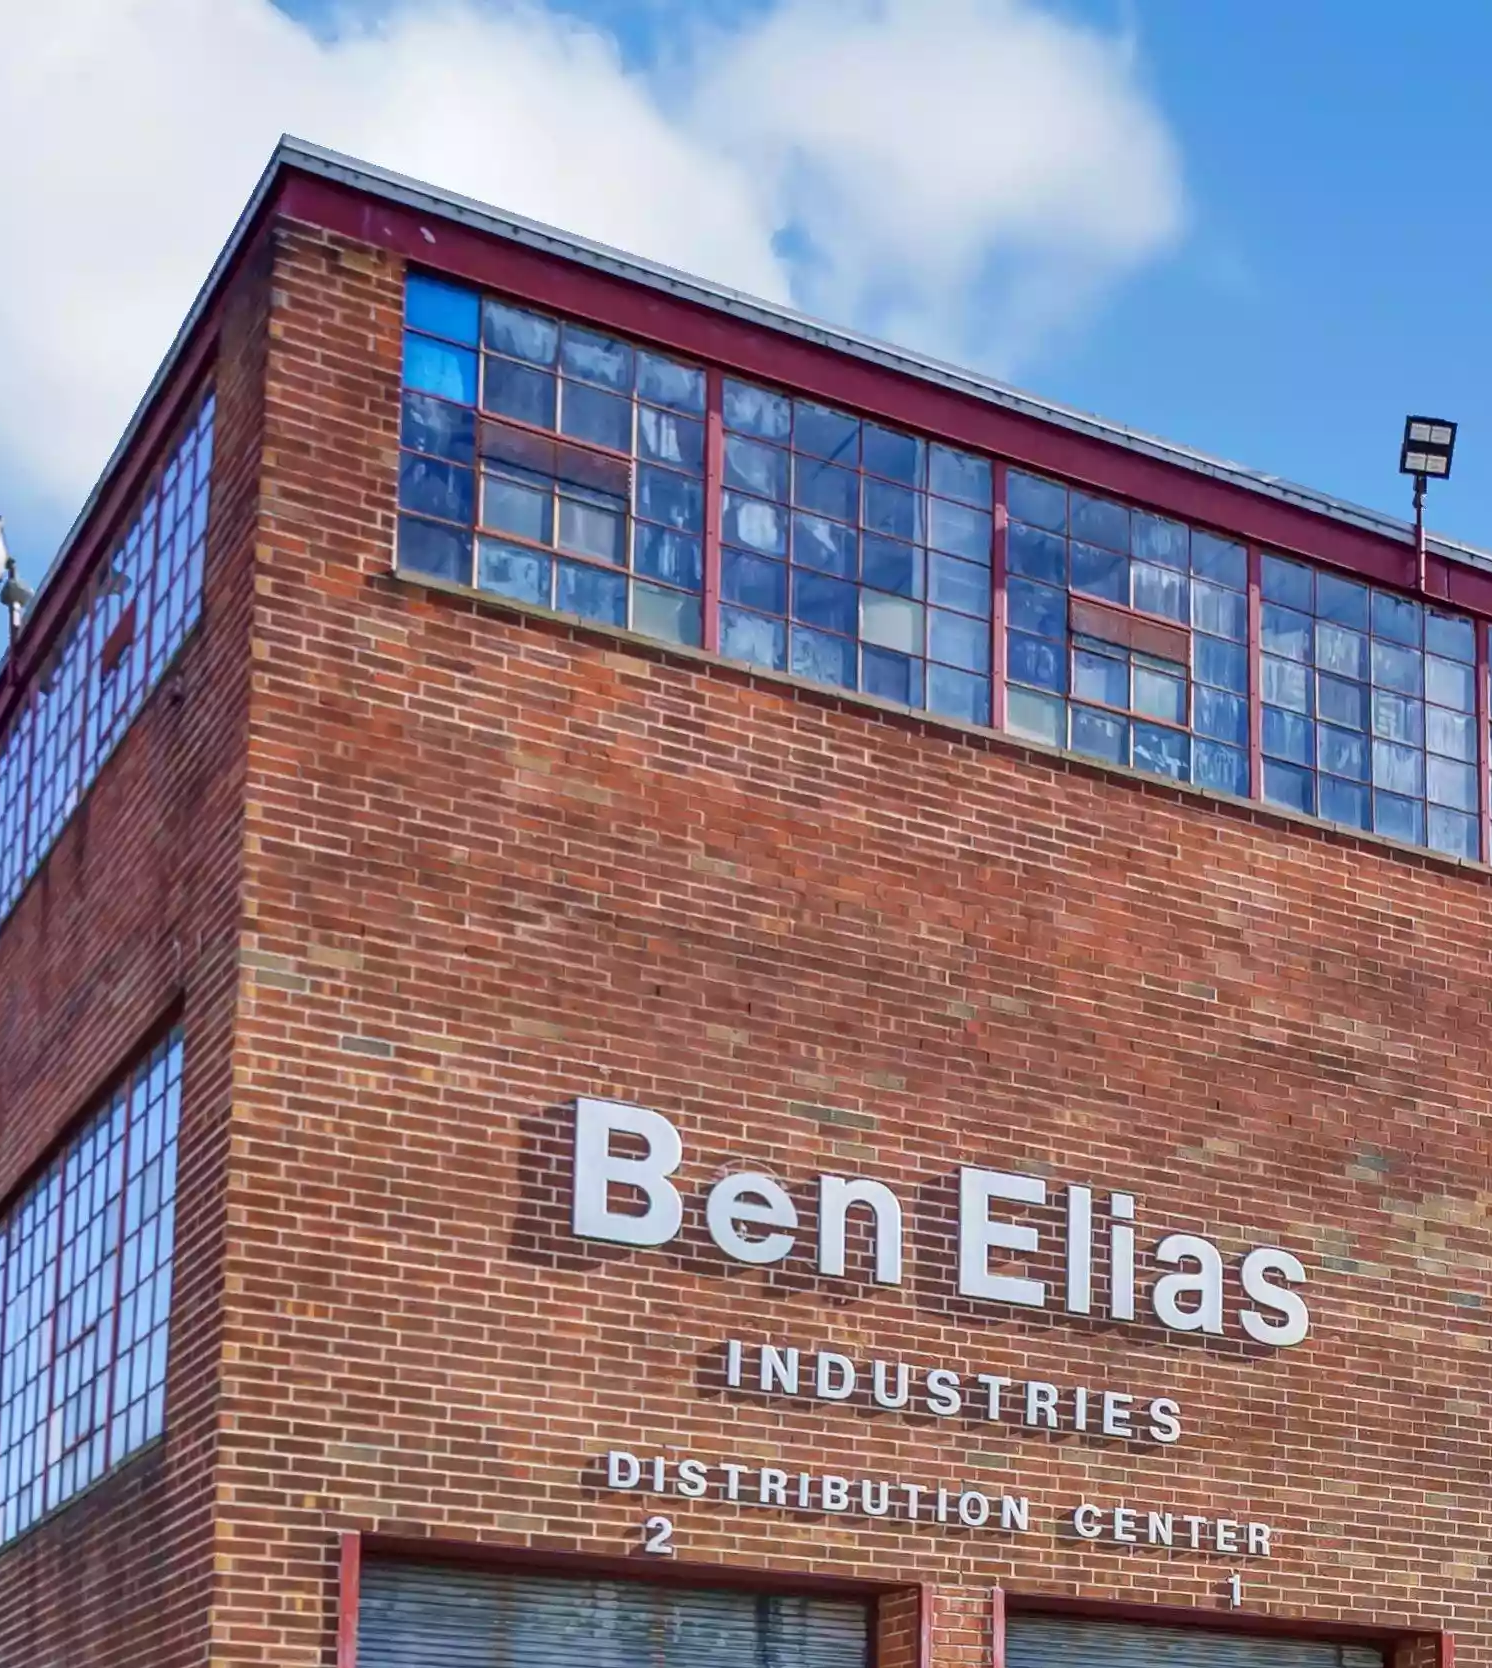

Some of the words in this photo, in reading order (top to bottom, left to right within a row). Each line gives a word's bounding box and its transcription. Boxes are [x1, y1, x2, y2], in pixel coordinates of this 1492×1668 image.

[572, 1097, 903, 1285] Ben
[958, 1165, 1310, 1346] Elias
[727, 1339, 1182, 1443] INDUSTRIES
[607, 1450, 1030, 1531] DISTRIBUTION
[1073, 1503, 1272, 1556] CENTER
[644, 1516, 674, 1554] 2
[1227, 1574, 1242, 1608] 1
